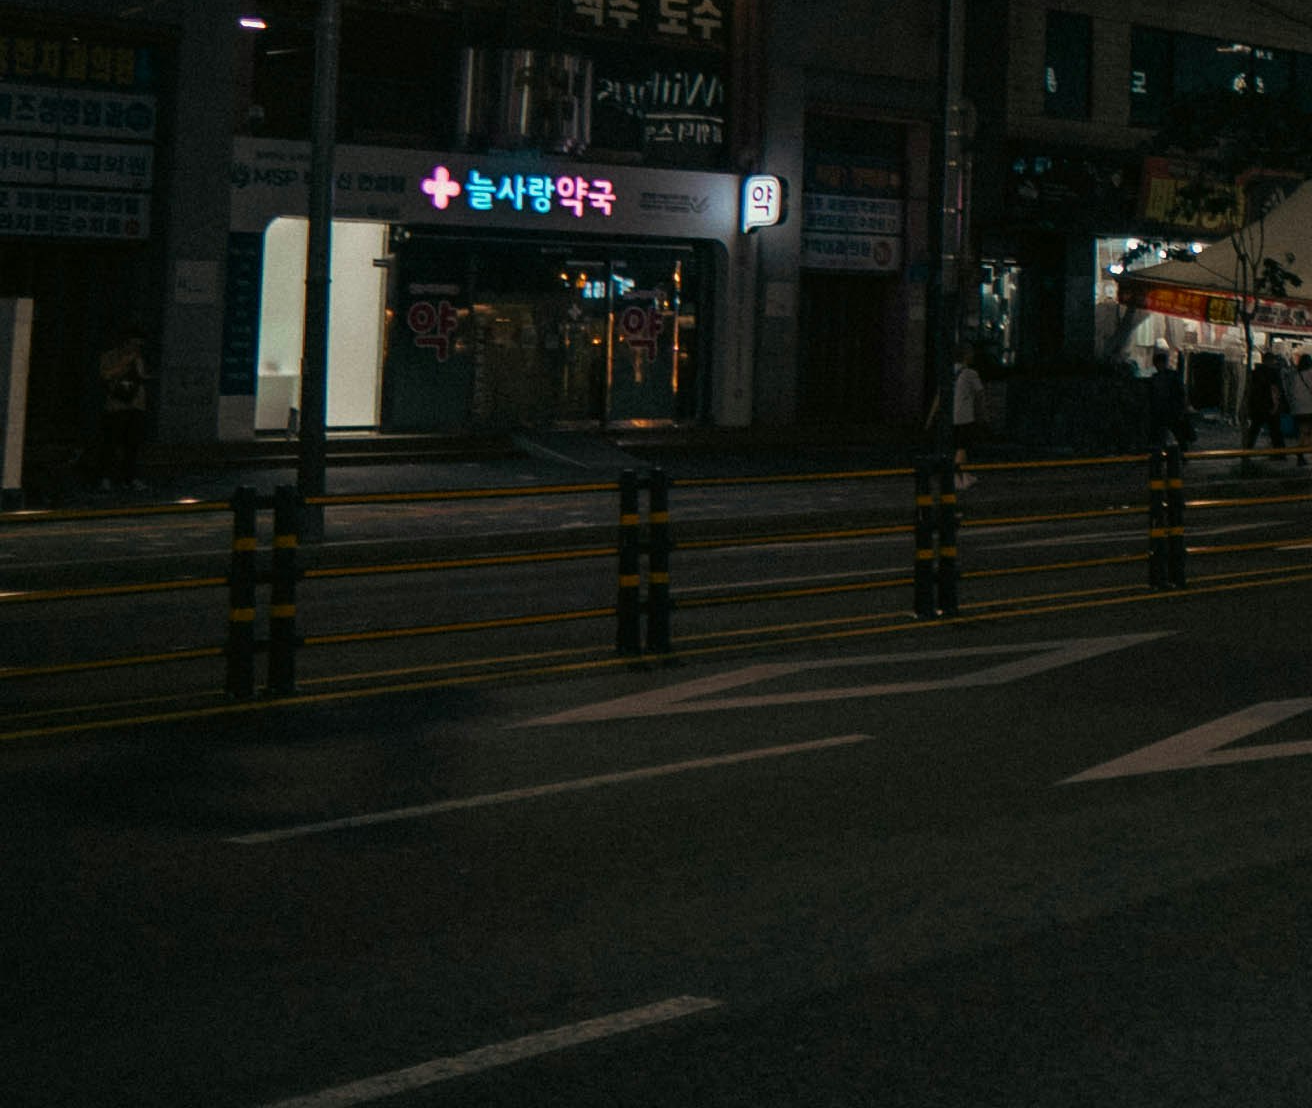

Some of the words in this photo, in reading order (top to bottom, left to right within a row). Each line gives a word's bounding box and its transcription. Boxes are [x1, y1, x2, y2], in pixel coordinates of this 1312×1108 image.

[464, 169, 617, 218] 늘사랑약국
[751, 183, 774, 216] 약
[408, 301, 458, 362] 약
